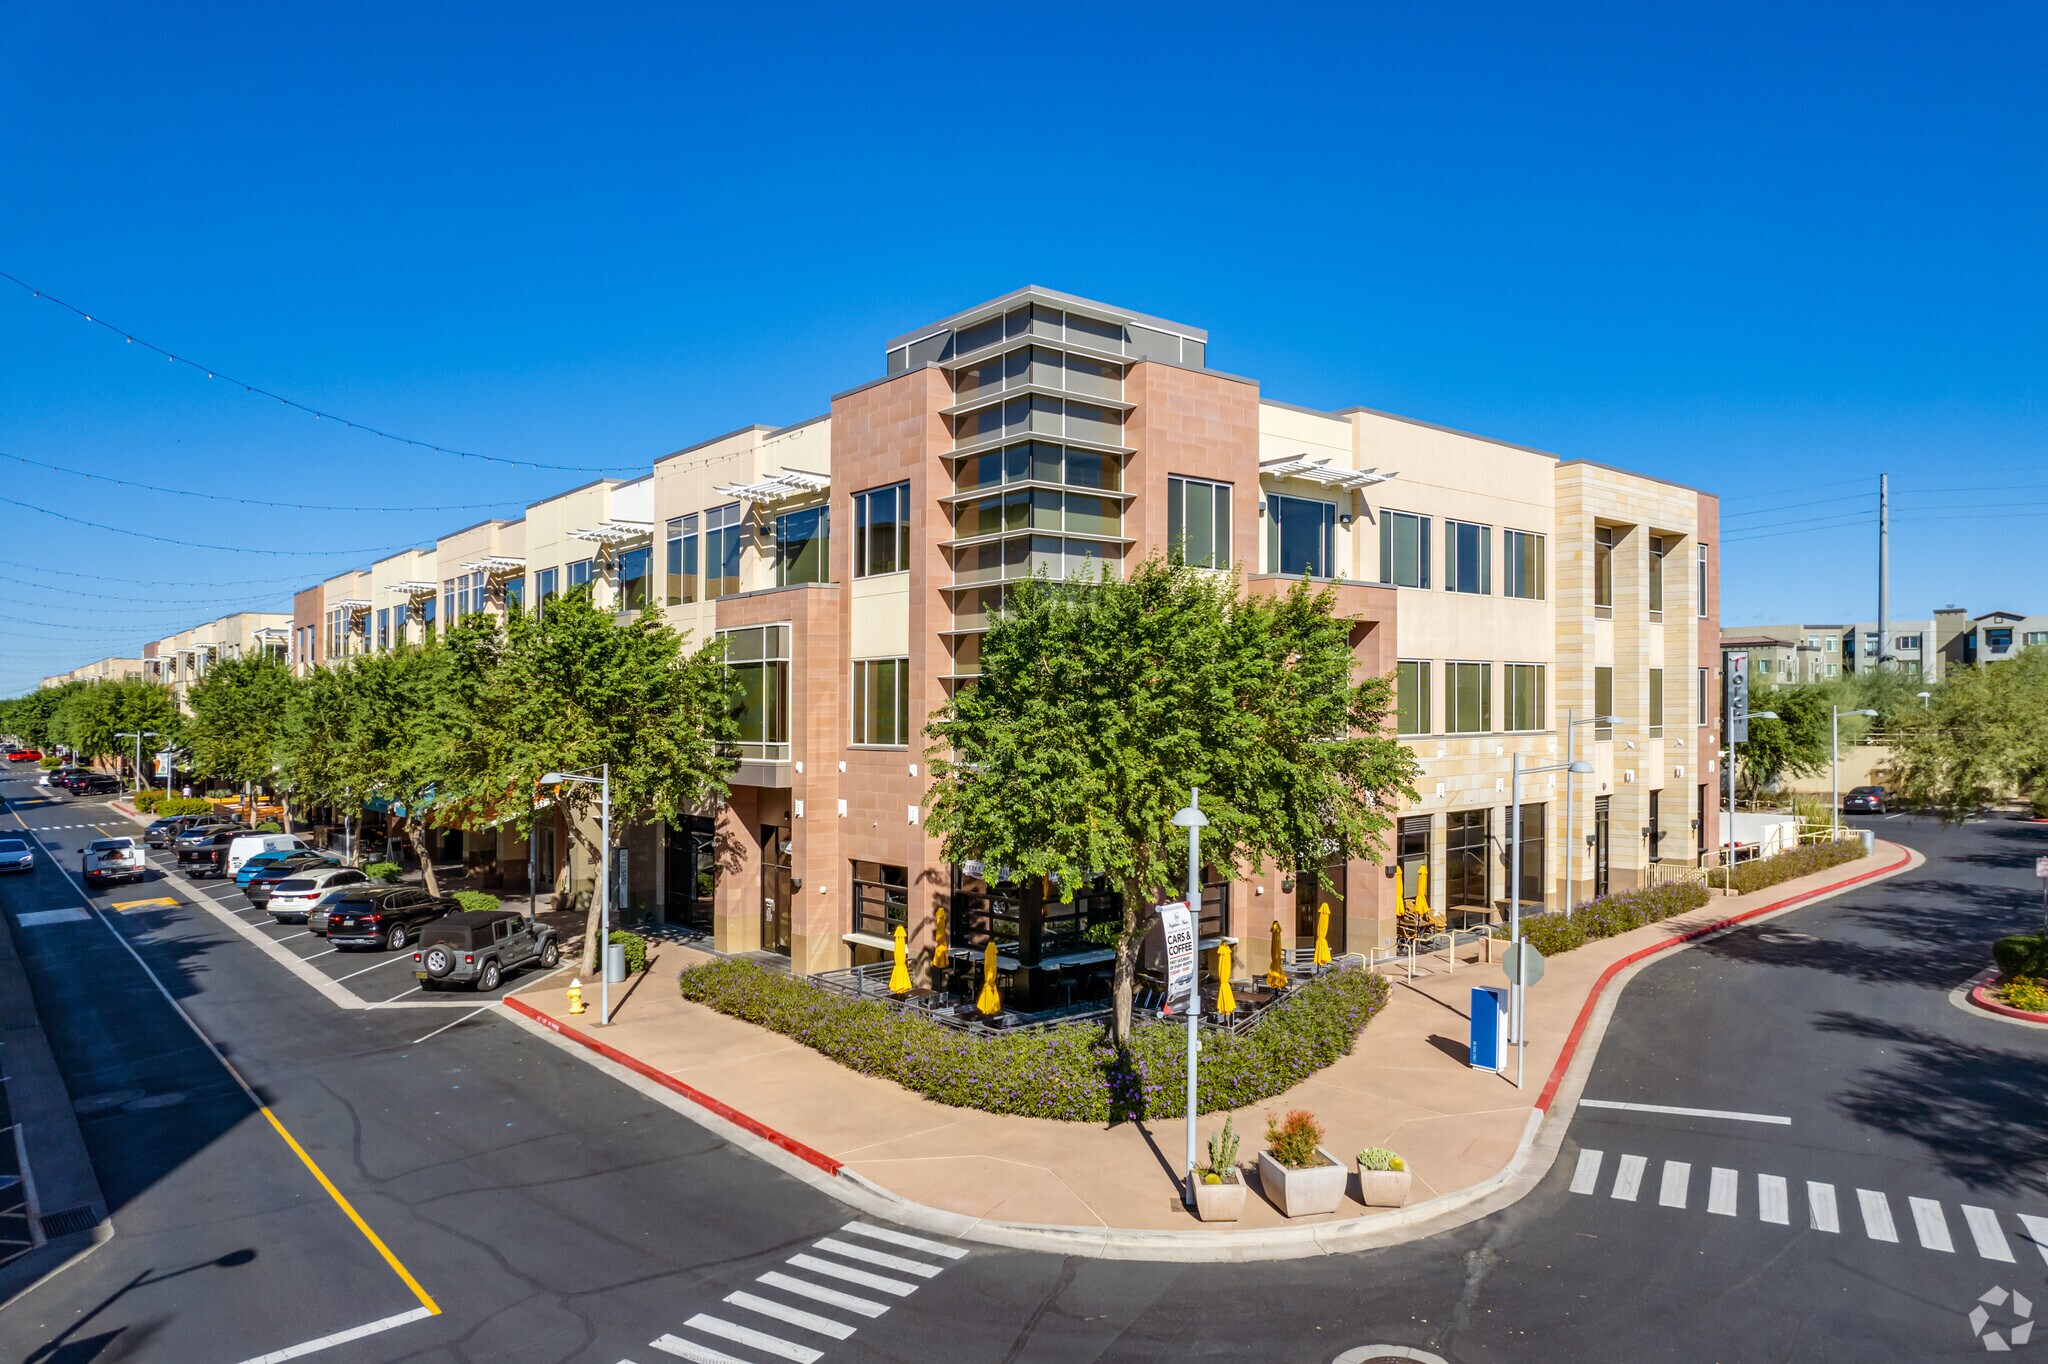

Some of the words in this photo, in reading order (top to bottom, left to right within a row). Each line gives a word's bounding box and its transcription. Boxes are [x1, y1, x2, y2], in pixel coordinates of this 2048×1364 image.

[1167, 932, 1185, 945] CARS
[1186, 931, 1192, 940] &
[1168, 941, 1192, 956] COFFEE
